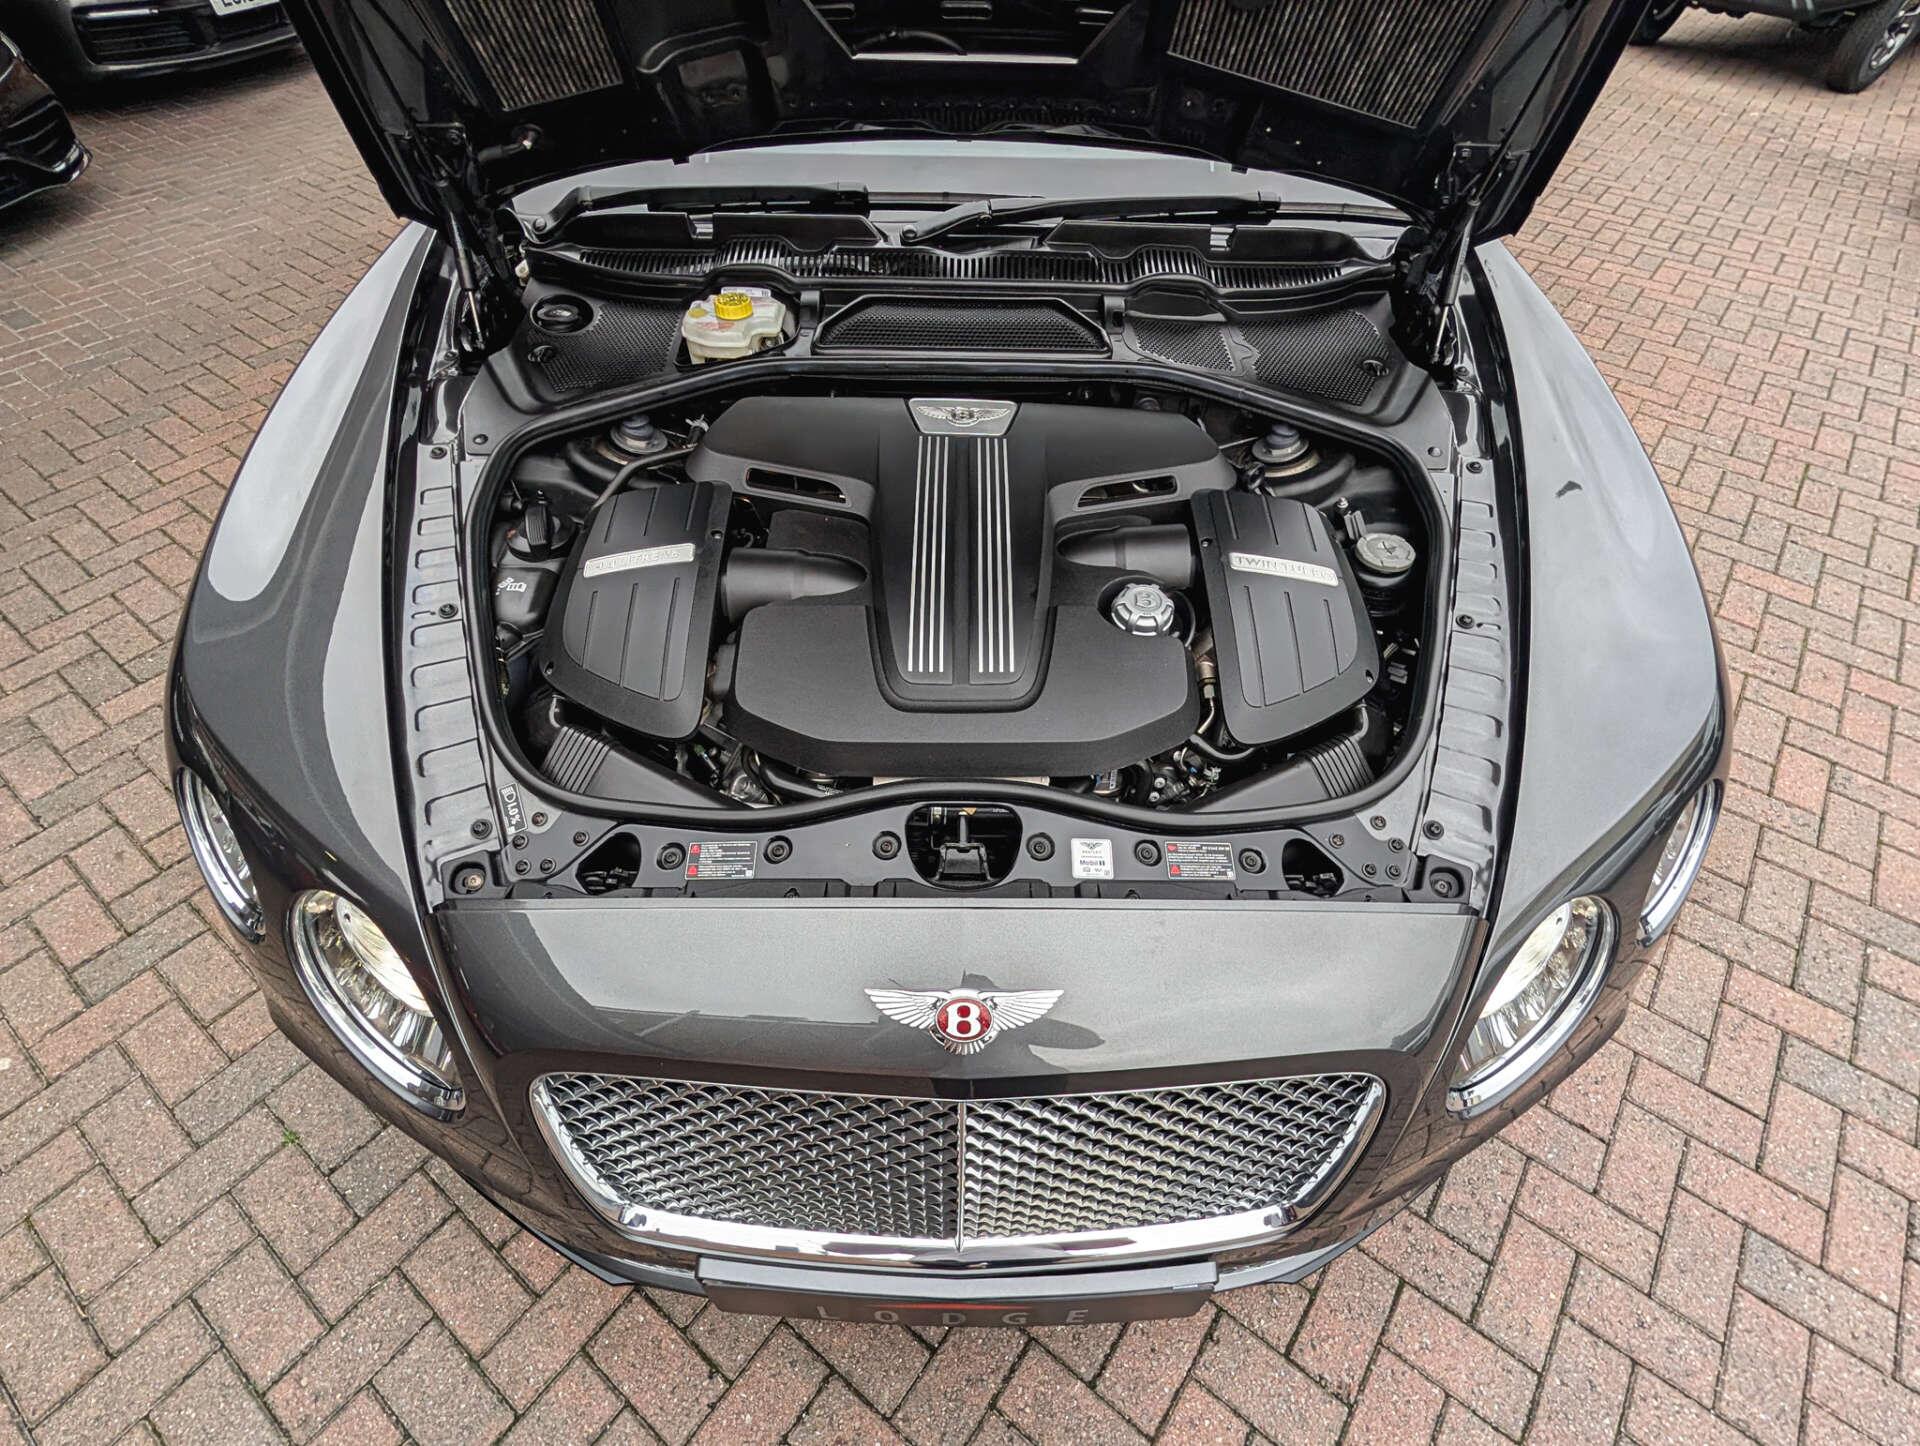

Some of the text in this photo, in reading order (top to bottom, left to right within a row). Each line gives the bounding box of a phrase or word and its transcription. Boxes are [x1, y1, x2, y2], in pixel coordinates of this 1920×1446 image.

[1233, 556, 1277, 570] TWIN
[945, 1002, 981, 1038] B
[816, 1305, 1089, 1325] LODGE
